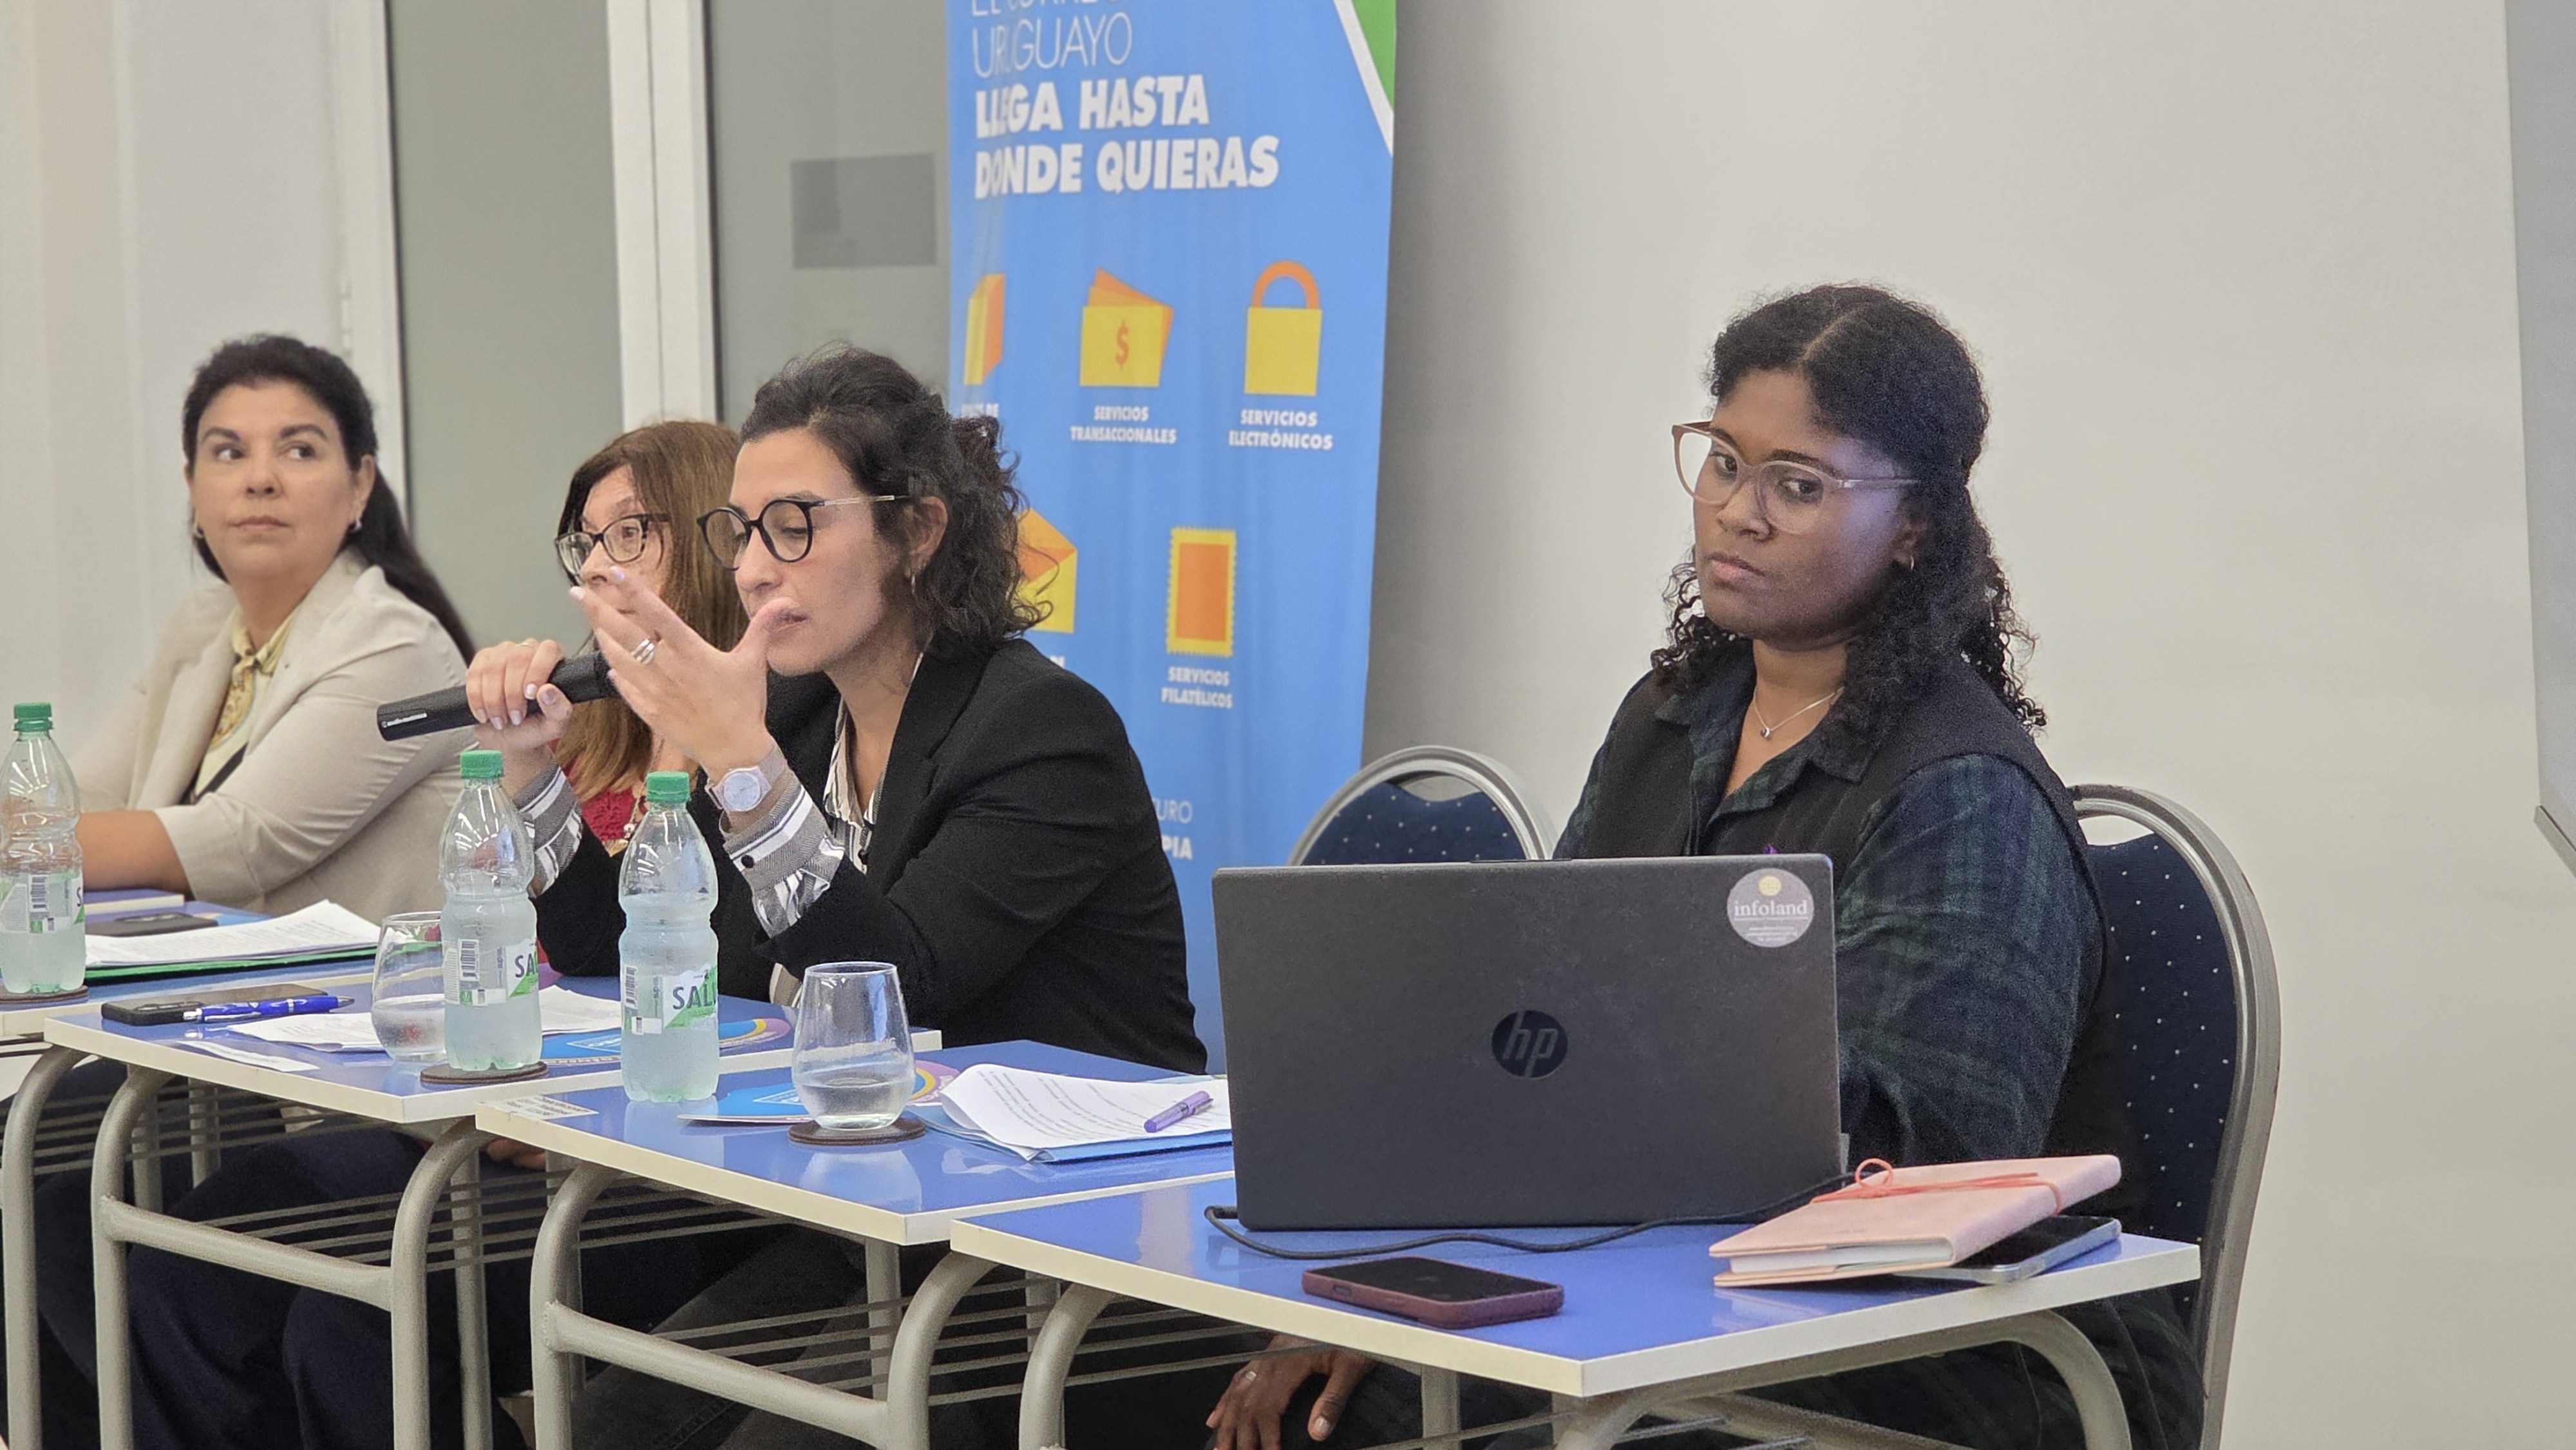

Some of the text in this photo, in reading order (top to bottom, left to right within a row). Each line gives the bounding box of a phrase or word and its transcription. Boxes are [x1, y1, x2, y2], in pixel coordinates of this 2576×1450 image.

[972, 12, 1132, 78] URGUAYO
[1079, 74, 1209, 130] HASTA
[974, 135, 1280, 199] DONDE QUIERAS
[1094, 405, 1149, 422] SERVICIOS
[1240, 409, 1318, 428] SERVICIOS
[1070, 425, 1177, 444] TRANSACCIONALES
[1228, 428, 1333, 451] ELECTRÓNICOS
[1168, 666, 1229, 686] SERVICIOS
[1161, 686, 1233, 709] FILATÉLICOS
[1734, 899, 1808, 917] infoland
[1501, 1010, 1559, 1078] hp
